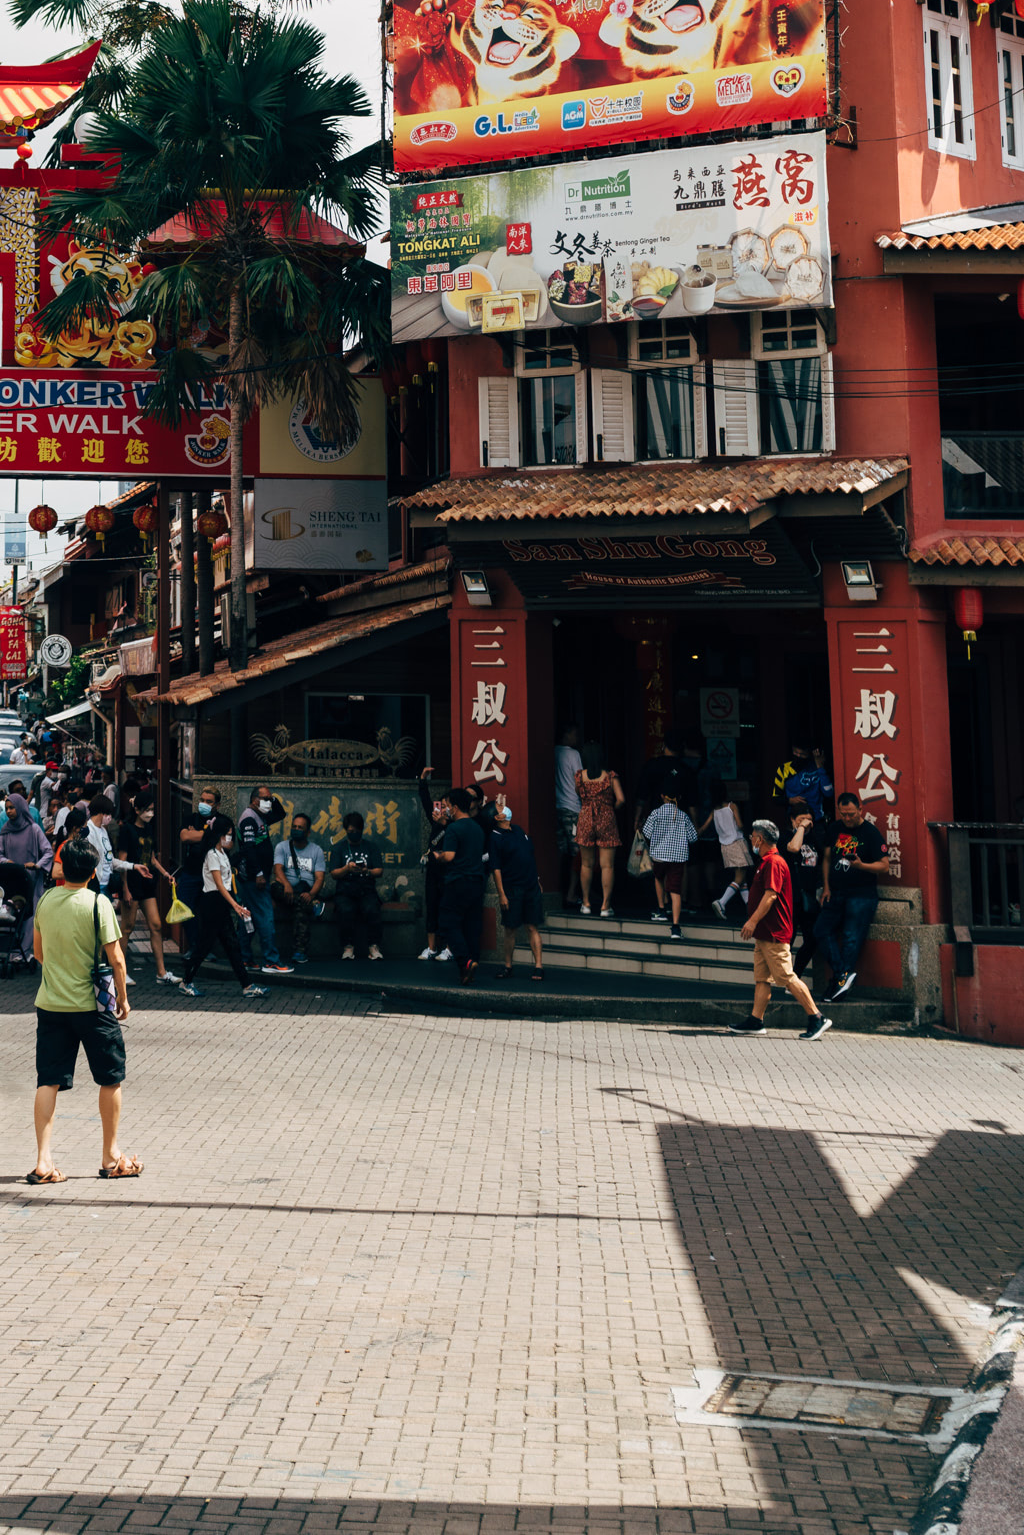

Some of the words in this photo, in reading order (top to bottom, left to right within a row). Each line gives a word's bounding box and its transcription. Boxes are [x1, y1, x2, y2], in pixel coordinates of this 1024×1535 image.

[777, 10, 788, 46] 壬寅年
[718, 75, 745, 87] TRUE
[718, 84, 751, 97] MELAKA
[514, 115, 533, 126] LED
[564, 111, 583, 120] AGM
[475, 114, 513, 136] G.L.
[672, 165, 726, 181] 马来西亚
[730, 149, 814, 210] 燕窝
[568, 188, 579, 198] Dr
[584, 184, 625, 196] Nutrition
[673, 180, 726, 200] 九鼎膳
[418, 193, 457, 207] 純正天然
[680, 202, 701, 210] Bird's
[565, 210, 633, 222] www.drnutrition.com.my
[508, 226, 527, 238] 南洋
[398, 237, 457, 254] TONGKAT
[460, 234, 480, 246] ALI
[407, 271, 472, 294] 東革阿里
[48, 414, 144, 435] WALK
[190, 440, 211, 458] JONKER
[212, 441, 226, 455] WALK
[292, 430, 316, 459] MELAKA
[309, 511, 355, 522] SHENG
[360, 512, 381, 523] TAI
[502, 537, 582, 562] San
[578, 536, 661, 560] Shu
[656, 534, 776, 566] Gong
[585, 571, 613, 584] House
[614, 576, 626, 585] of
[627, 575, 667, 586] Authentic
[668, 570, 710, 585] Delicacies
[1, 616, 24, 626] GONG
[7, 628, 18, 638] XI
[8, 640, 19, 649] FA
[5, 651, 22, 661] CAI
[471, 626, 507, 784] 三叔公
[851, 627, 898, 803] 三叔公
[302, 747, 364, 762] Malacca
[886, 812, 902, 879] 有限公司
